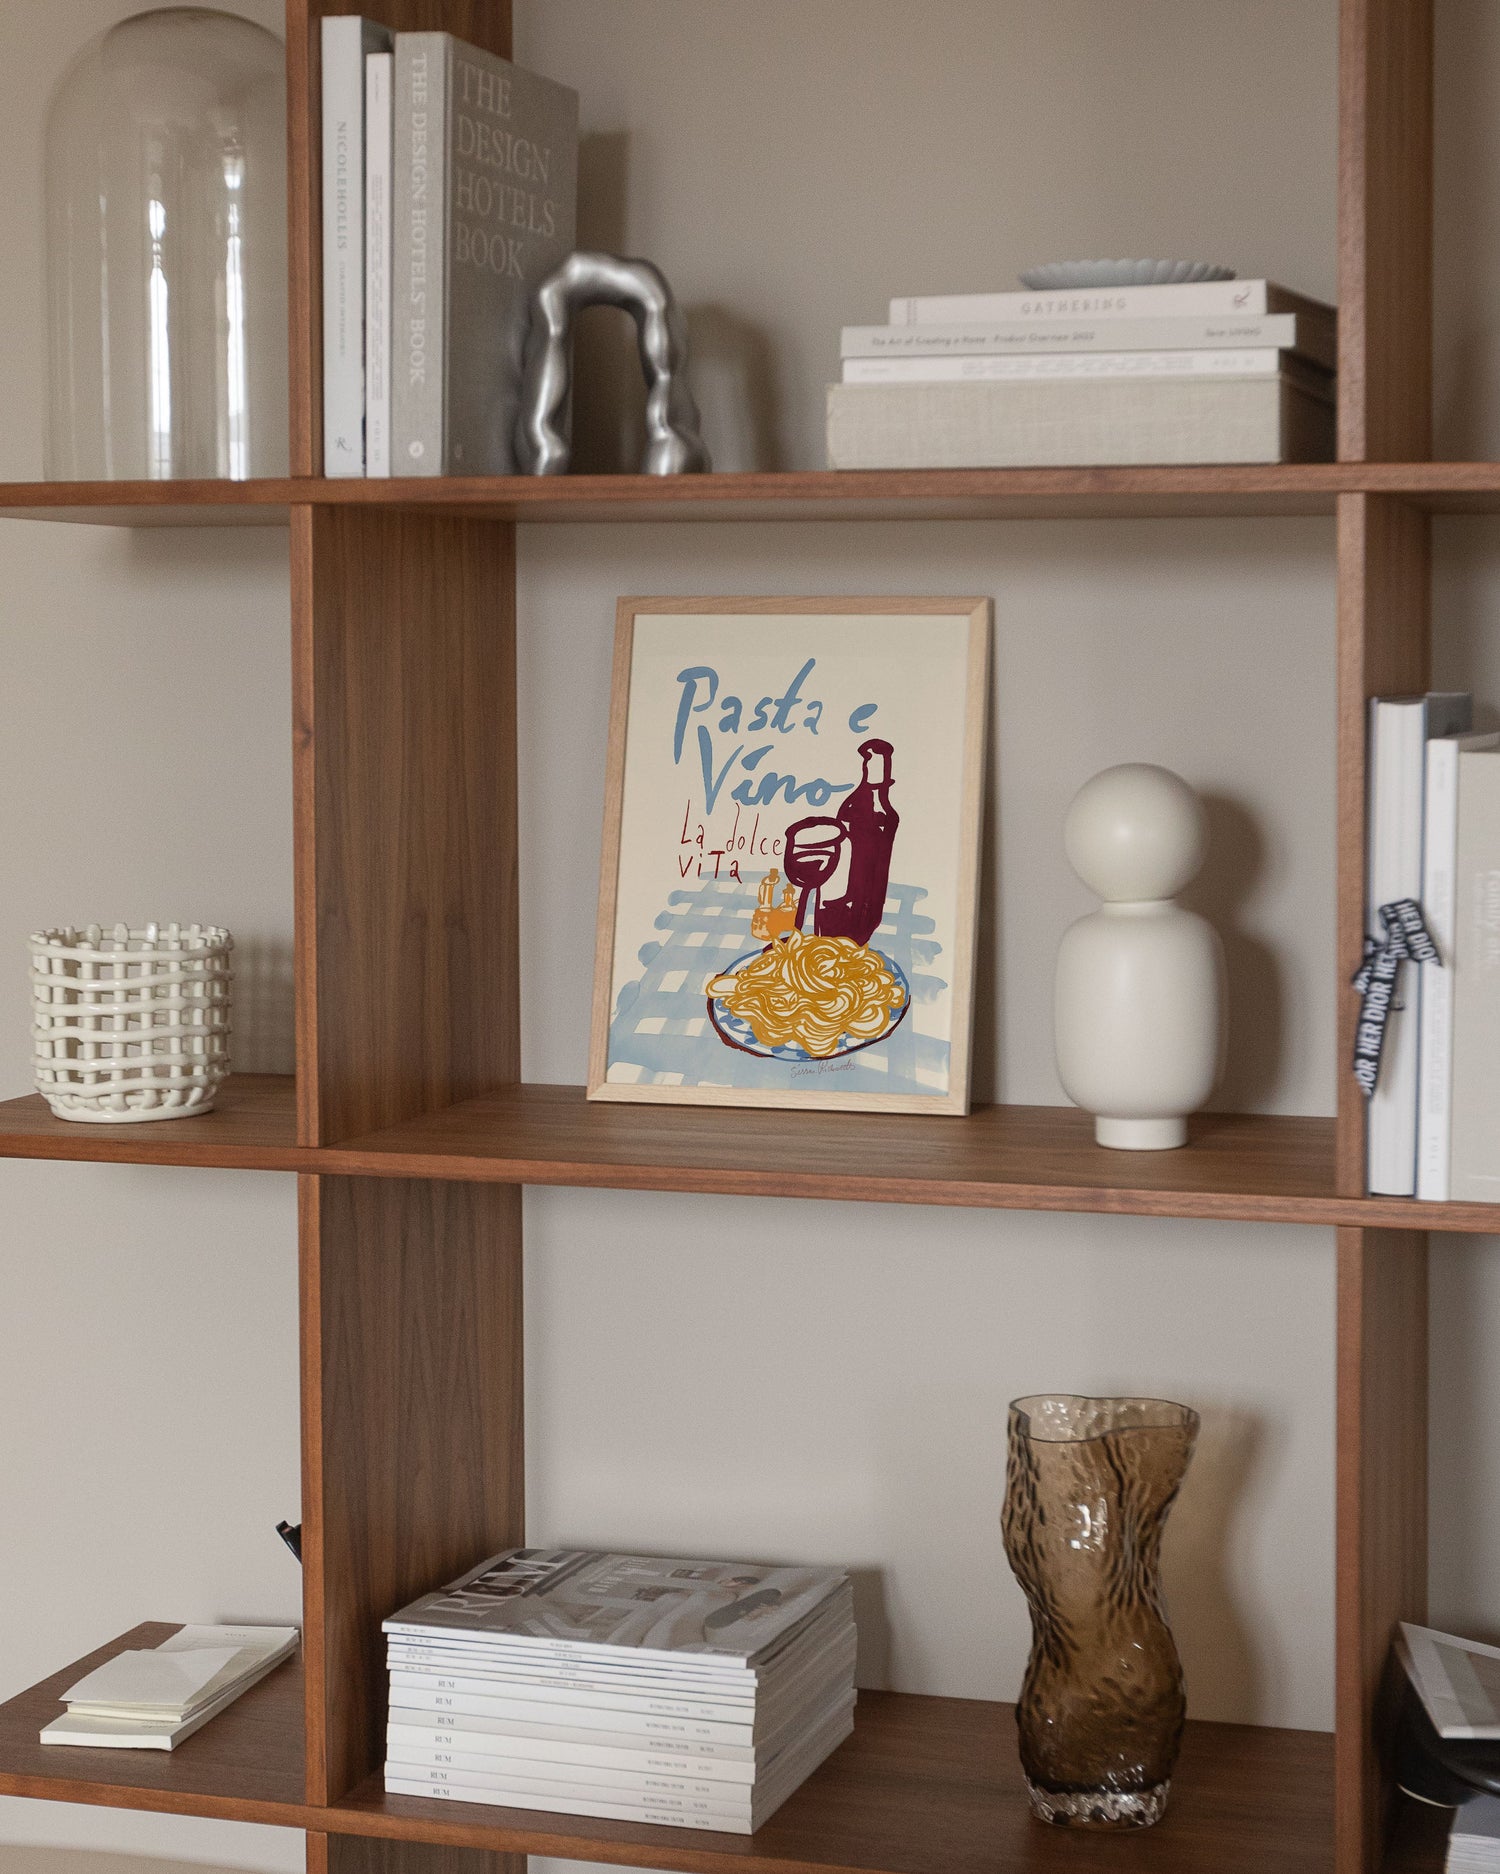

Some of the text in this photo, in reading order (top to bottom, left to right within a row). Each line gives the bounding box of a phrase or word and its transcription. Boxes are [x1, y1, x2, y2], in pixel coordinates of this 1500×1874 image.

[410, 52, 426, 105] THE
[457, 61, 512, 119] THE
[410, 111, 426, 200] DESIGN
[456, 114, 551, 184] DESIGN
[455, 168, 556, 238] HOTELS
[454, 222, 525, 280] BOOK
[1020, 297, 1128, 315] GATHERING
[409, 317, 425, 385] BOOK
[674, 658, 878, 765] Pasta e
[697, 725, 855, 816] Vino
[680, 799, 783, 856] La dolce
[1362, 981, 1393, 1021] DIOR
[1356, 1022, 1384, 1056] HER
